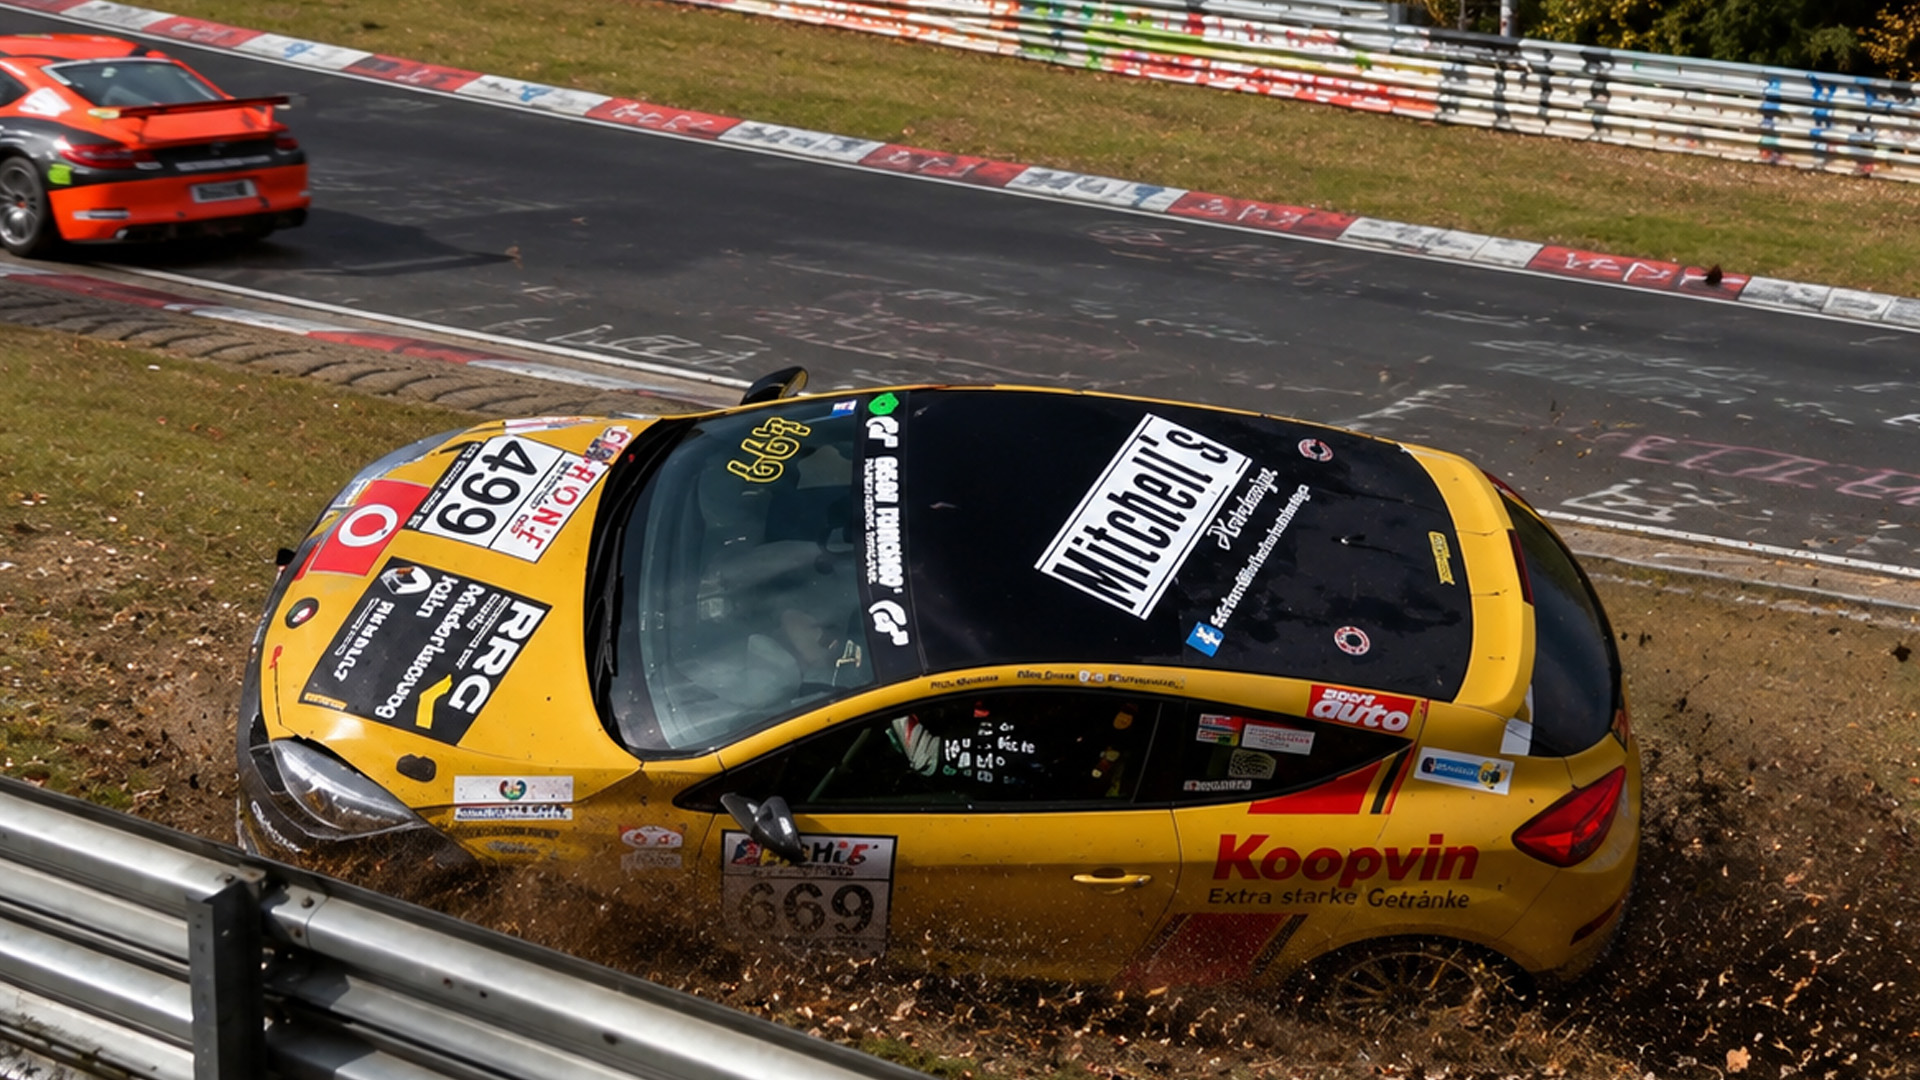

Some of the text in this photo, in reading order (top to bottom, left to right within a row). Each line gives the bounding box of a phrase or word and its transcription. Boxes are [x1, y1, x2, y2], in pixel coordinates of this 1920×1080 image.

[436, 440, 538, 536] 499
[1053, 430, 1229, 610] Mitchell's
[448, 600, 545, 715] RRG
[1312, 698, 1409, 732] auto
[1213, 834, 1479, 888] Koopvin
[739, 882, 874, 935] 669
[1208, 888, 1271, 904] Extra
[1281, 887, 1357, 905] starke
